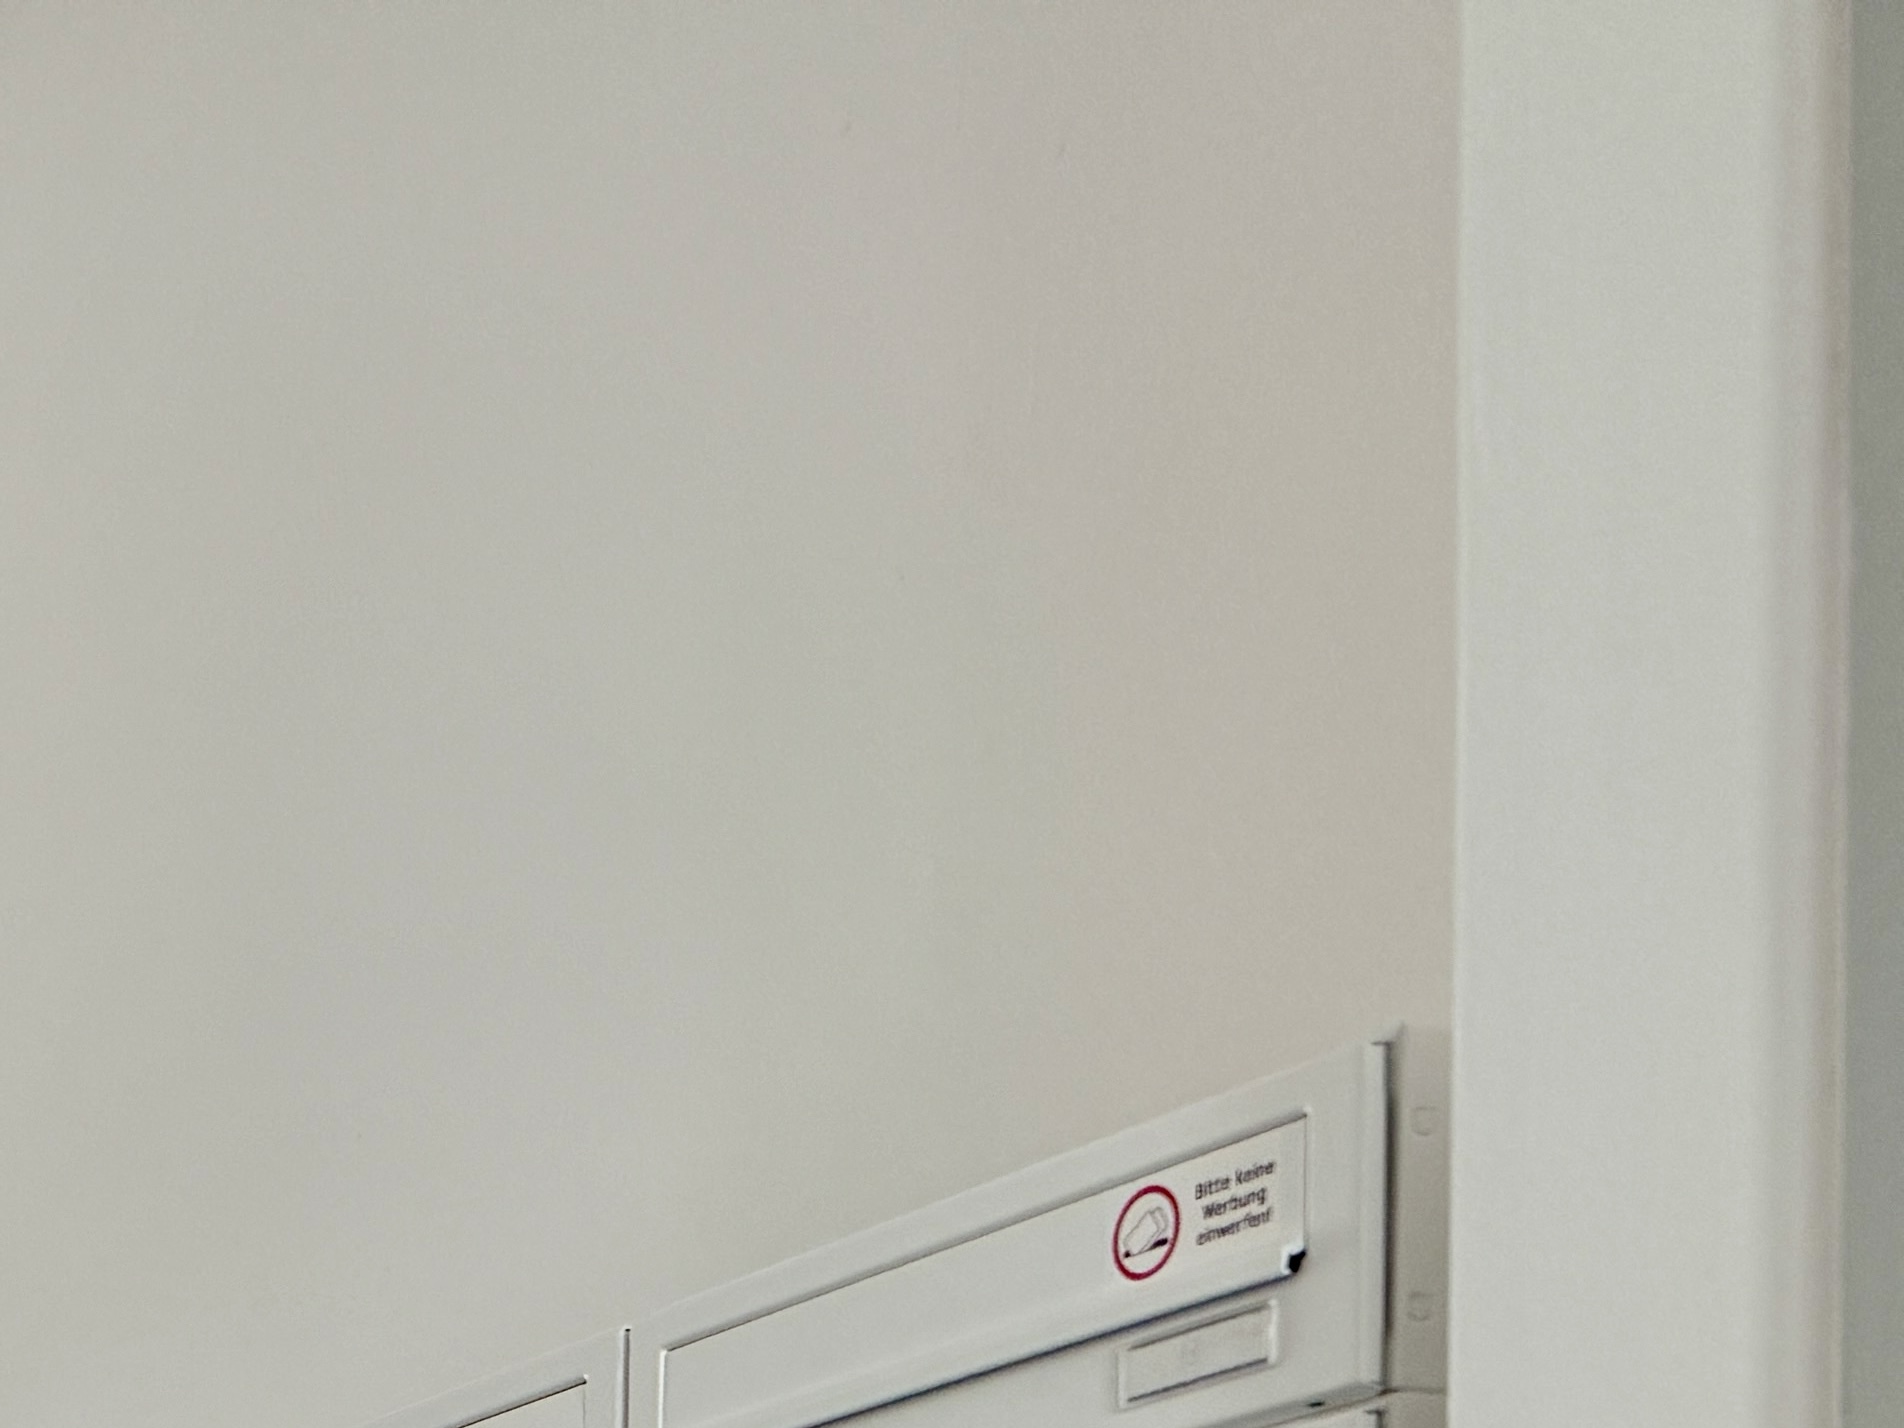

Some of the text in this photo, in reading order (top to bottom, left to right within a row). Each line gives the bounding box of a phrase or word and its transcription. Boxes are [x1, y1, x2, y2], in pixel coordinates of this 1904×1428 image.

[1195, 1161, 1276, 1201] Bitte keine
[1202, 1187, 1267, 1219] Werbung
[1195, 1206, 1273, 1246] einwerfen!
